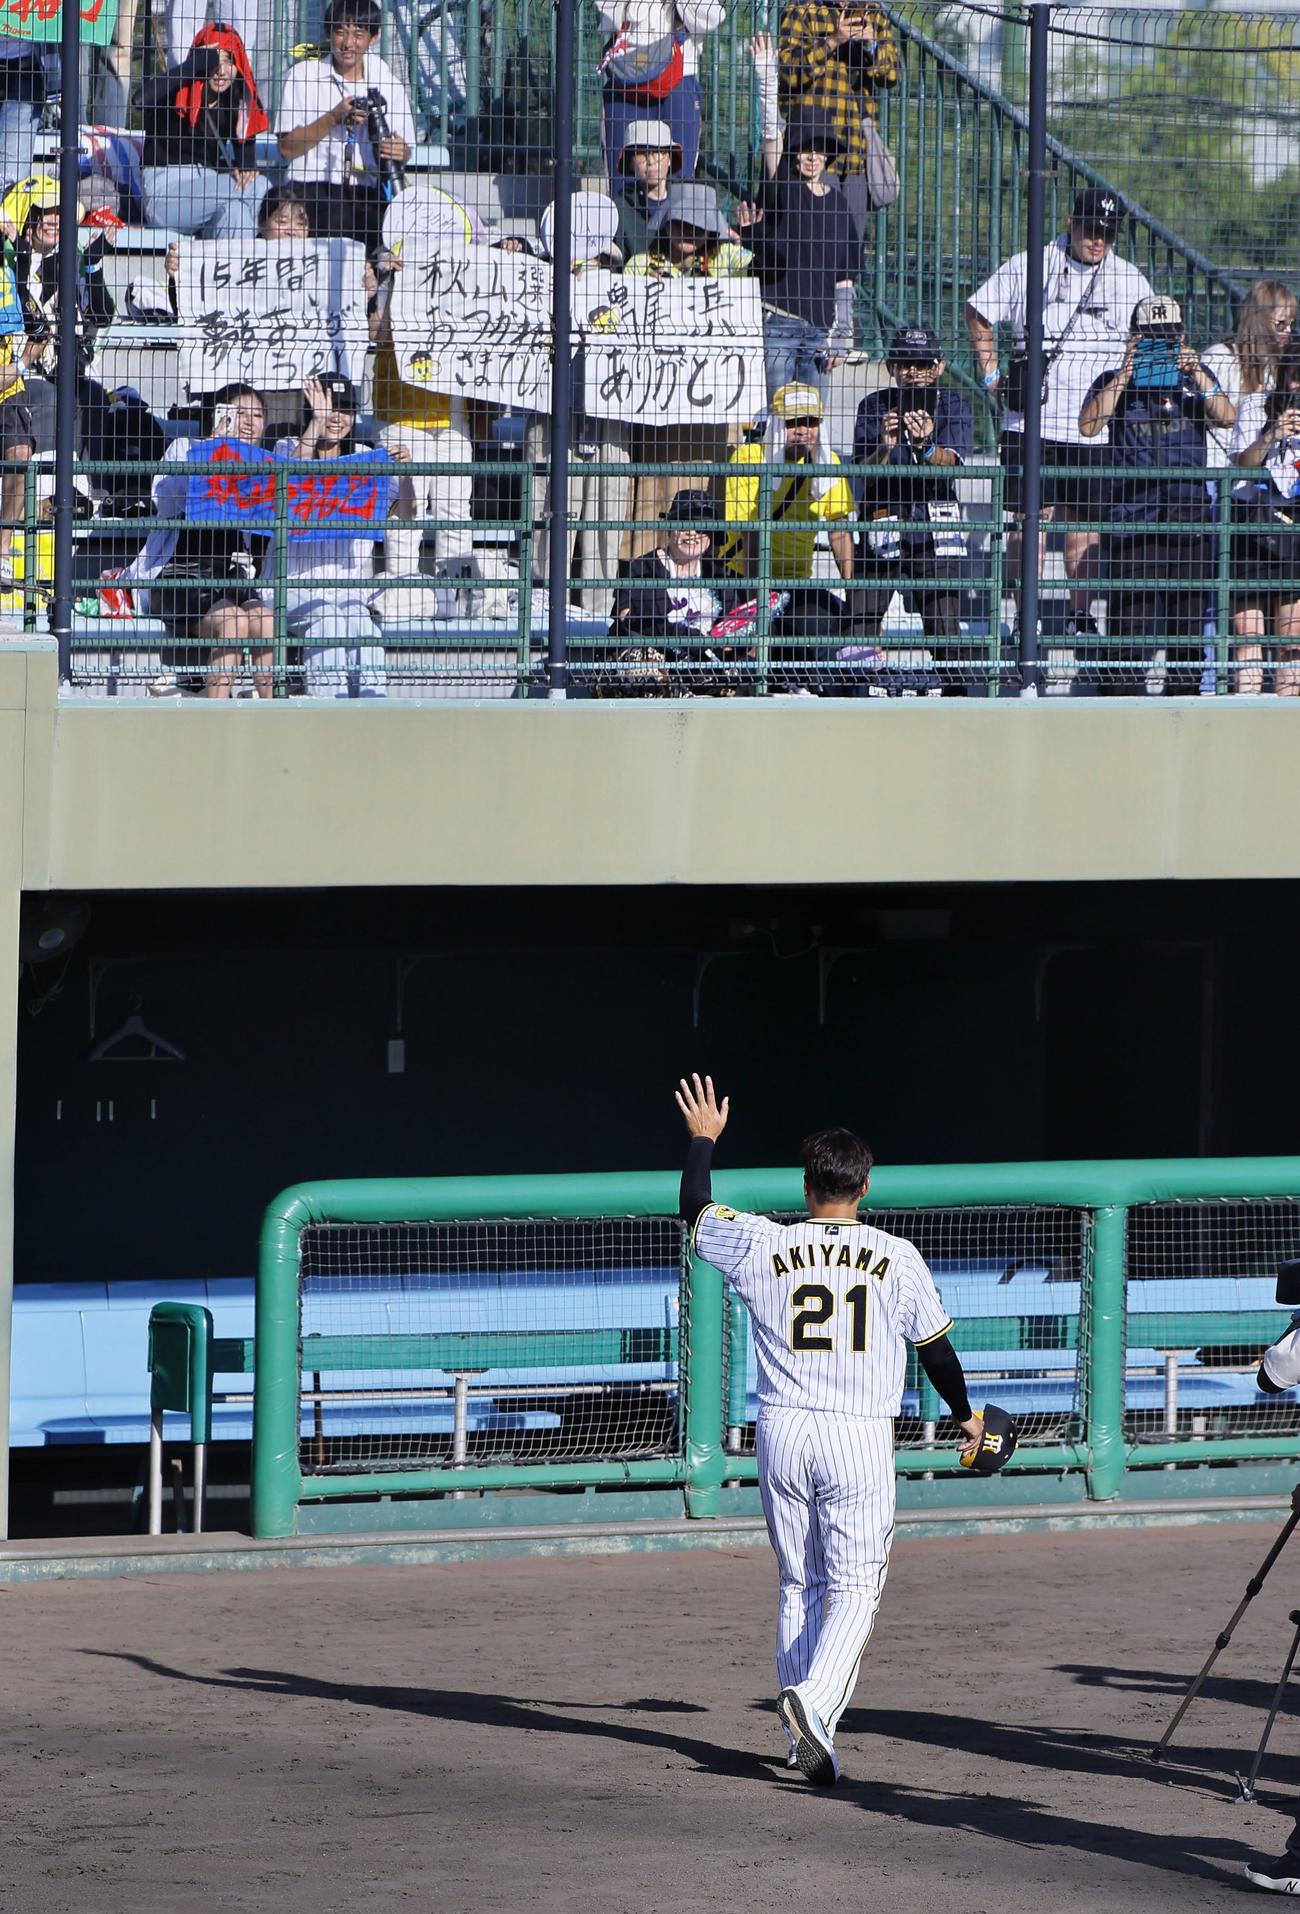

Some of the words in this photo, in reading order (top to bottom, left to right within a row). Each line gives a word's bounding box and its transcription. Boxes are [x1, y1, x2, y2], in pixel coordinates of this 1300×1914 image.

[200, 253, 320, 302] 15年間
[417, 250, 553, 311] 秋山選
[599, 347, 746, 414] ありがとう
[772, 1244, 890, 1281] AKIYAMA
[791, 1283, 868, 1353] 21
